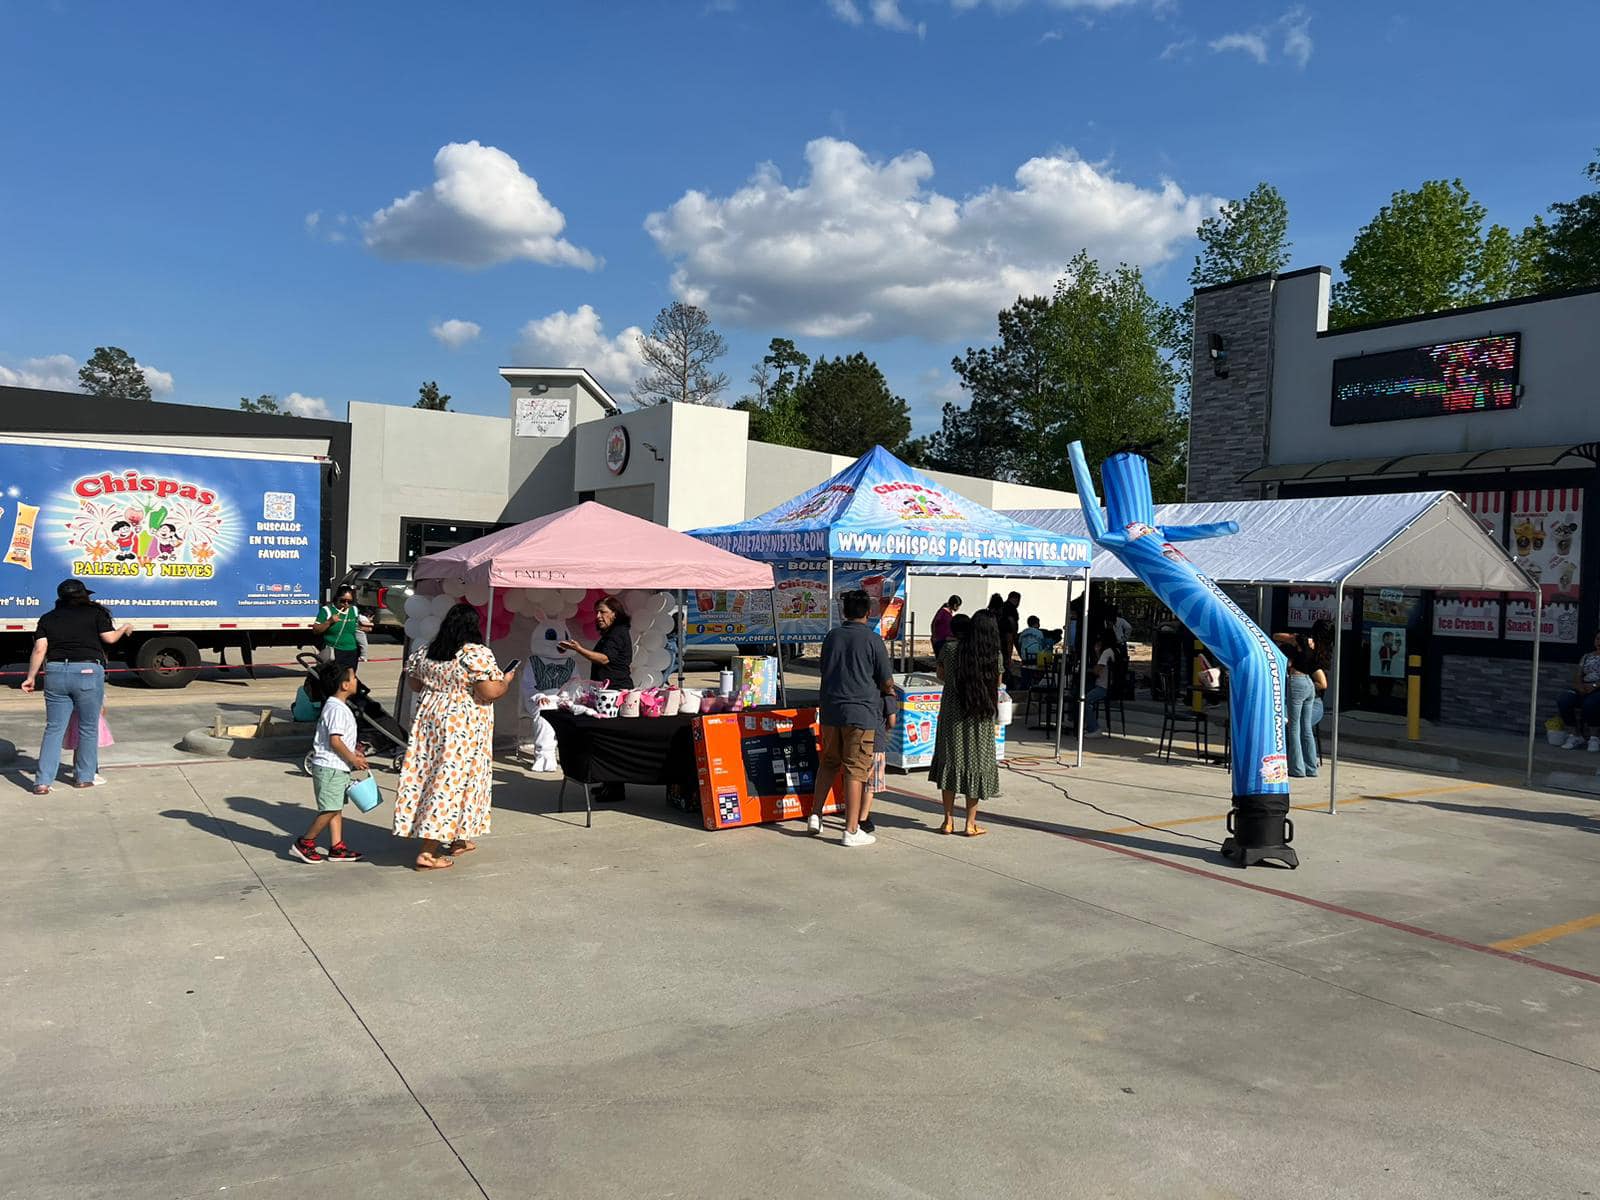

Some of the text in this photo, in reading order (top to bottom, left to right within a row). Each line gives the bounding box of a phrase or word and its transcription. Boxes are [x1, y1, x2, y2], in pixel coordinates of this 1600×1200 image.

[75, 472, 216, 505] Chispas
[256, 522, 301, 532] BUSCALOS
[249, 536, 308, 546] EN TU TIENDA
[838, 532, 1088, 561] WWW.CHISPAS PALETASYNIEVES.COM
[258, 549, 300, 559] FAVORITA
[74, 561, 213, 578] PALETAS Y NIEVES
[1439, 617, 1453, 629] Ice
[1454, 618, 1486, 631] Cream
[1506, 619, 1532, 633] Snack
